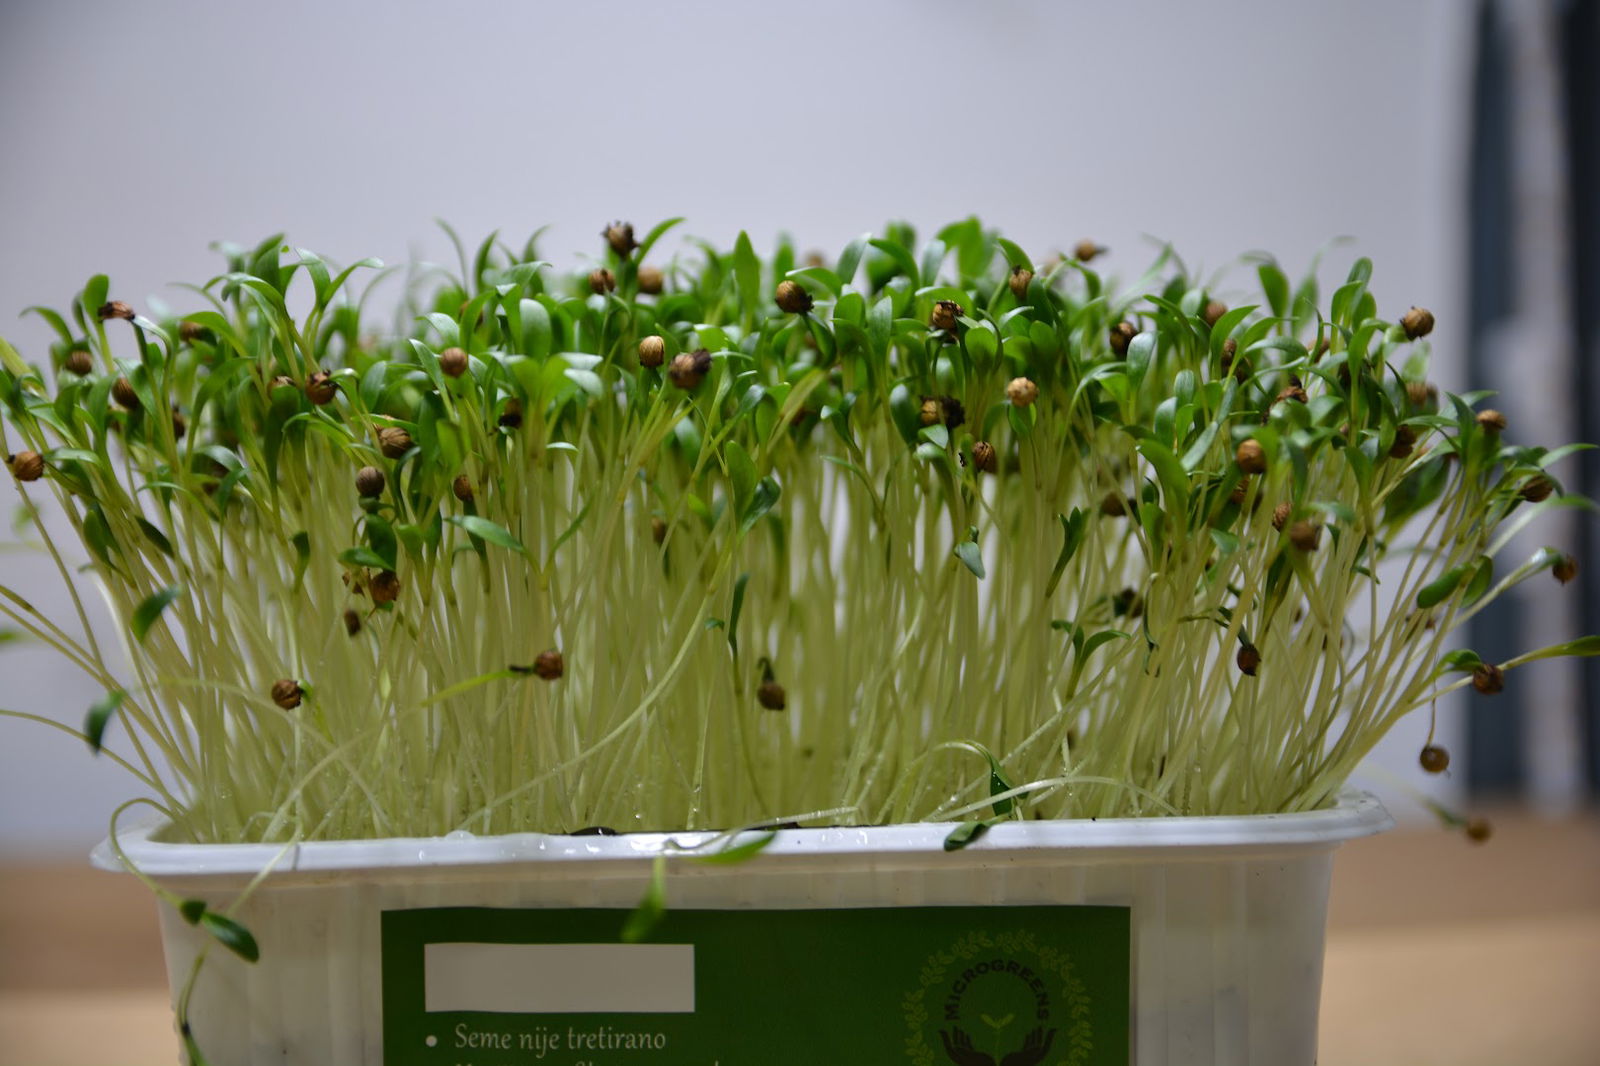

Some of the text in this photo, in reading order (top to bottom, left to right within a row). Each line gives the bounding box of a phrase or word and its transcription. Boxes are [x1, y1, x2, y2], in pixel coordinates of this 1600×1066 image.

[945, 959, 1049, 1020] MICROGREENS
[454, 1023, 666, 1059] Seme nije tretirano
